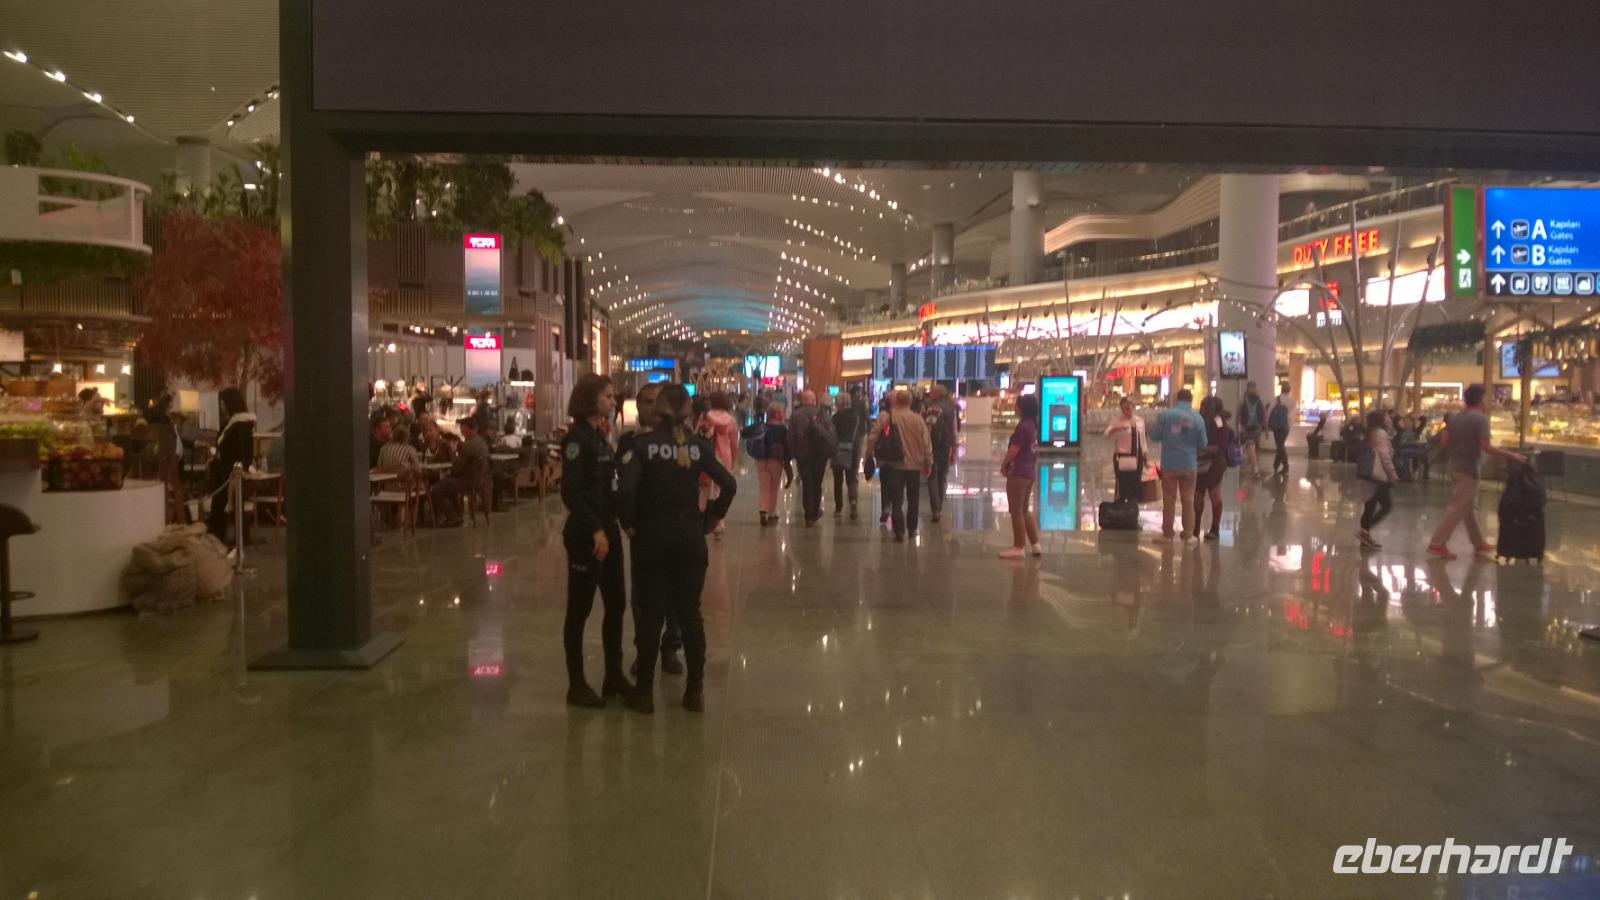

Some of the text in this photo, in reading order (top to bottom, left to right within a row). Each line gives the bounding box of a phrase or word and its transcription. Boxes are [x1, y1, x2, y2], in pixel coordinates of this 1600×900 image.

[1531, 219, 1547, 240] A
[1550, 232, 1573, 240] Gates
[1532, 244, 1546, 266] B
[1548, 257, 1571, 266] Gates
